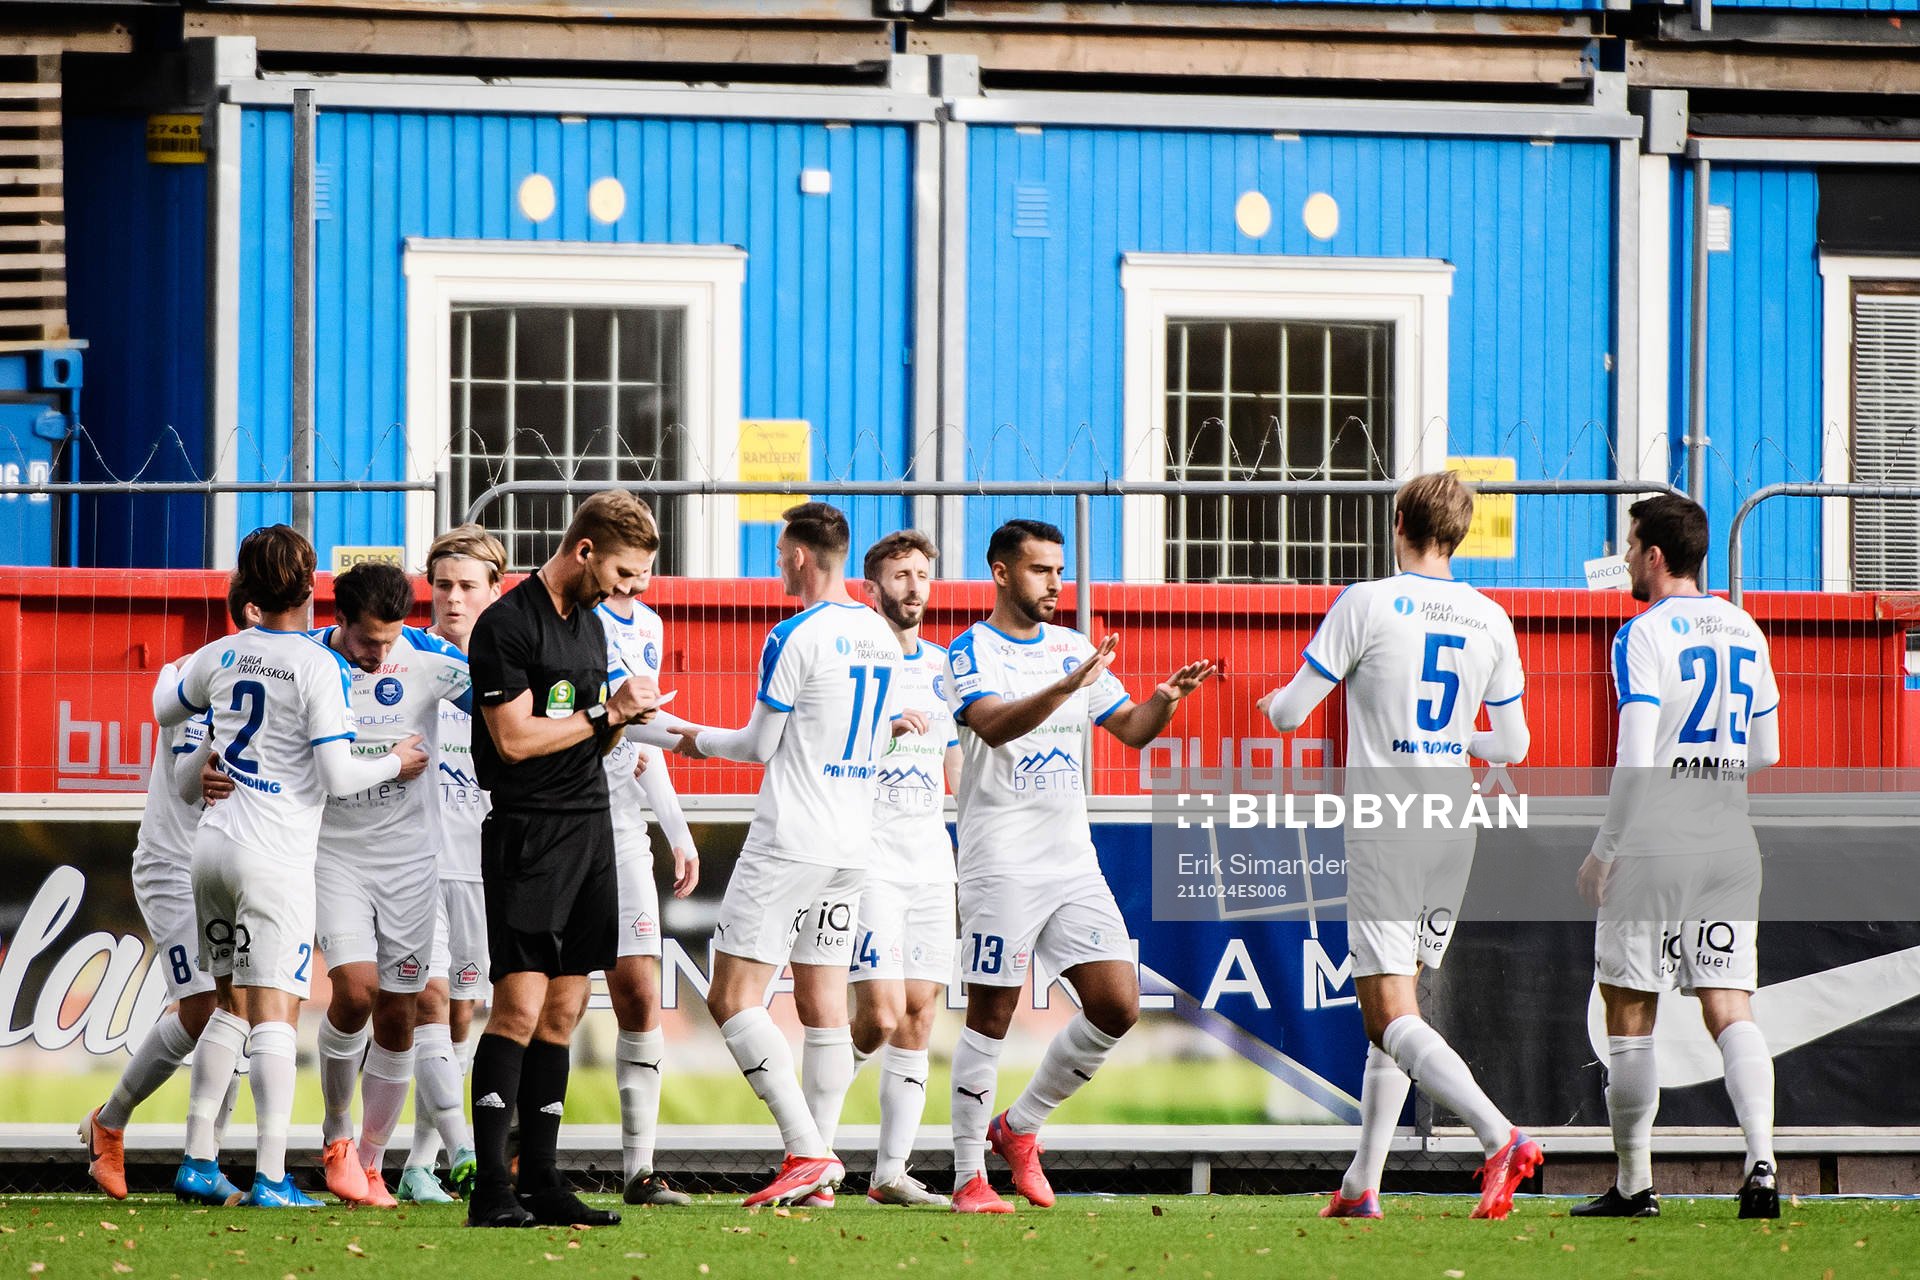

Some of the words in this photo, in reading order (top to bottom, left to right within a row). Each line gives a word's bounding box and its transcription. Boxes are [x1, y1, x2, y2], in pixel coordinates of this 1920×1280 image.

[743, 451, 801, 464] RAMIRENT
[1421, 601, 1453, 612] JARLA
[1425, 612, 1488, 631] TRAFIKSKOLA
[237, 655, 262, 665] JARLA
[238, 664, 295, 681] TRAFIKSKOLA
[1417, 632, 1466, 731] 5
[1678, 646, 1756, 745] 25
[225, 680, 266, 774] 2
[841, 665, 892, 761] 11
[1014, 771, 1079, 791] belle
[1671, 756, 1719, 780] PAN
[1697, 919, 1734, 953] iQ
[168, 944, 192, 984] 8
[294, 943, 312, 982] 2
[971, 933, 1005, 974] 13
[1696, 951, 1730, 968] fuel
